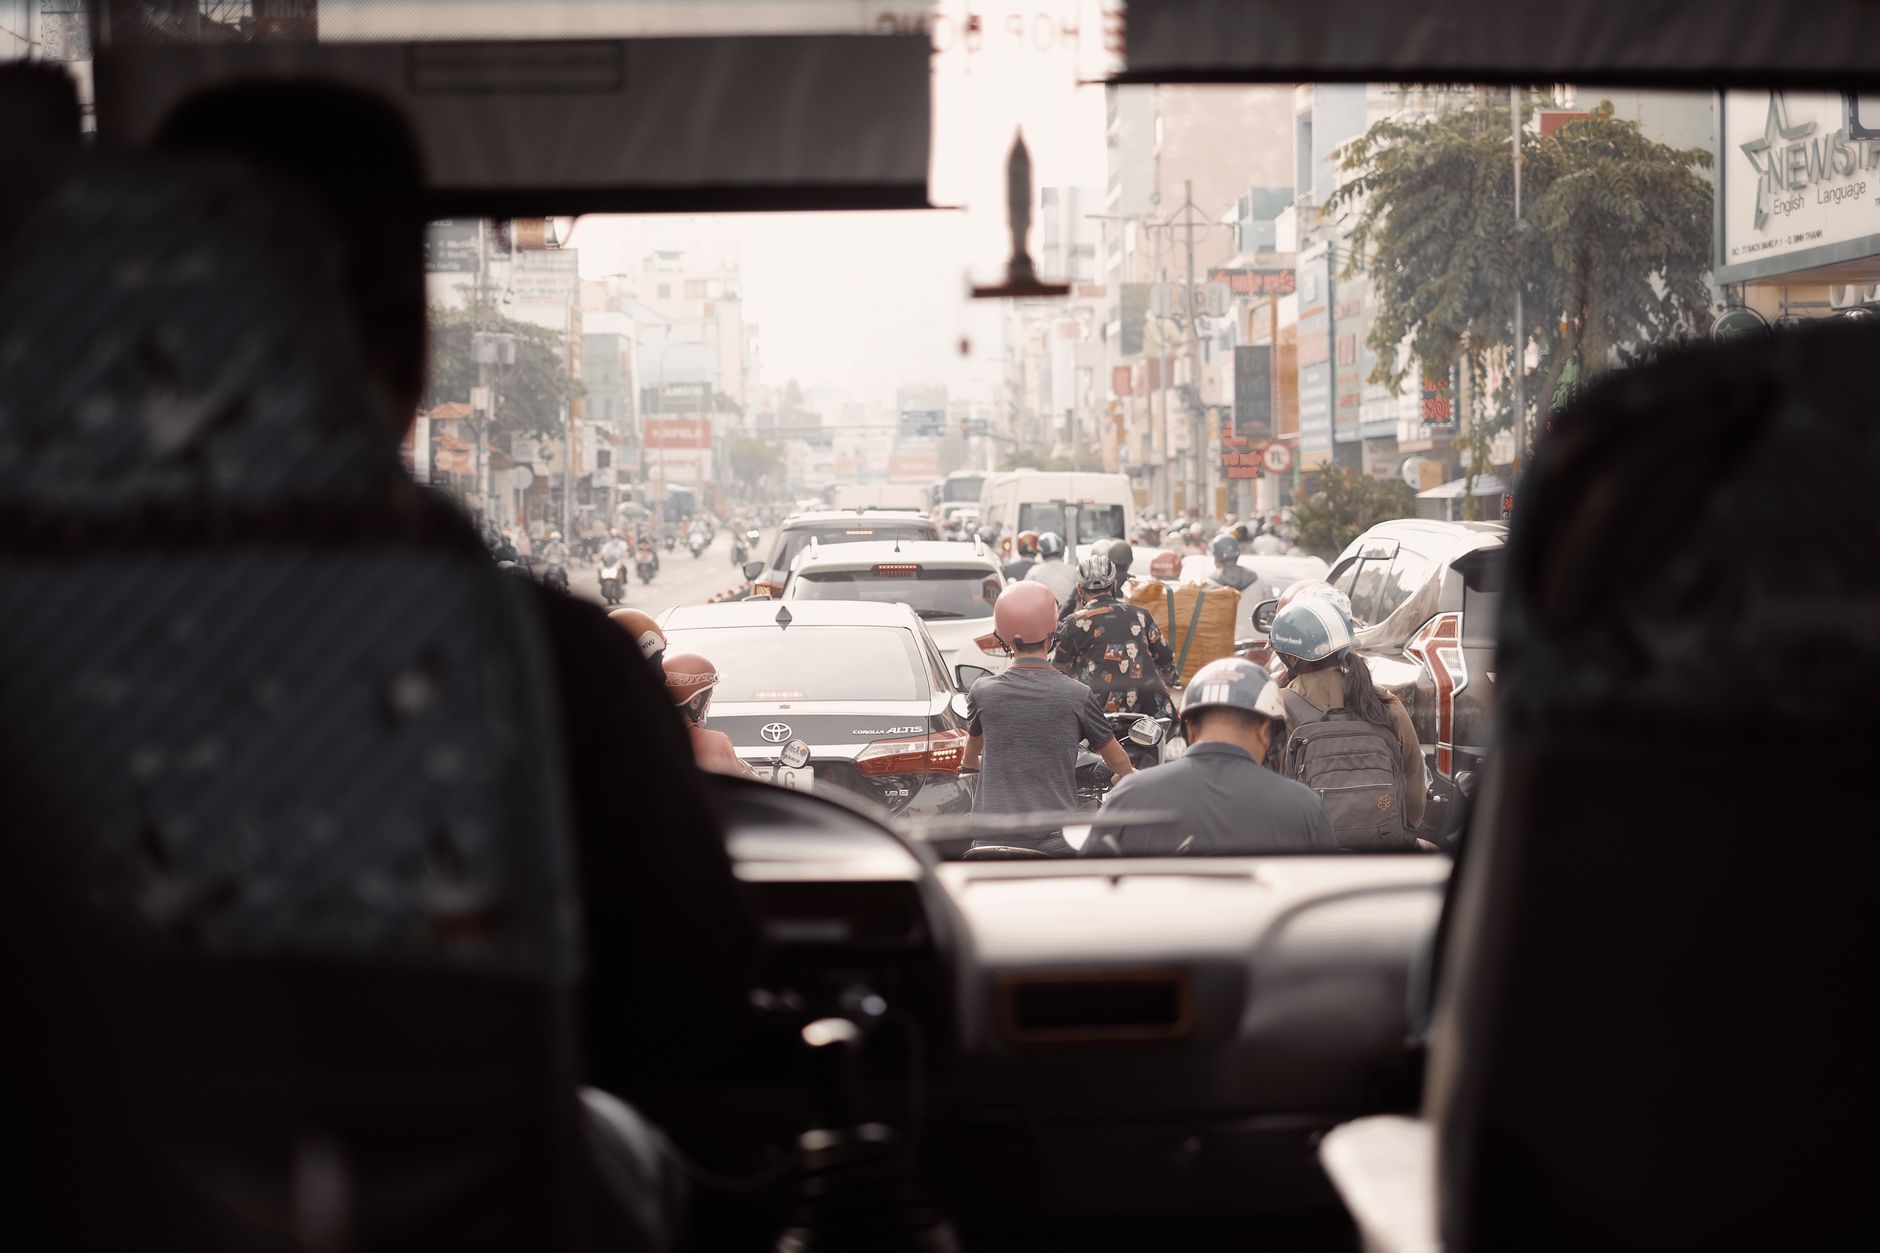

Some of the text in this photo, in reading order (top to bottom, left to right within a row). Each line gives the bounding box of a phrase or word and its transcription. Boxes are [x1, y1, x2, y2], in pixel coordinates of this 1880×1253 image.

[1773, 194, 1805, 216] English
[1817, 181, 1866, 205] Language
[885, 726, 923, 734] ALTIS
